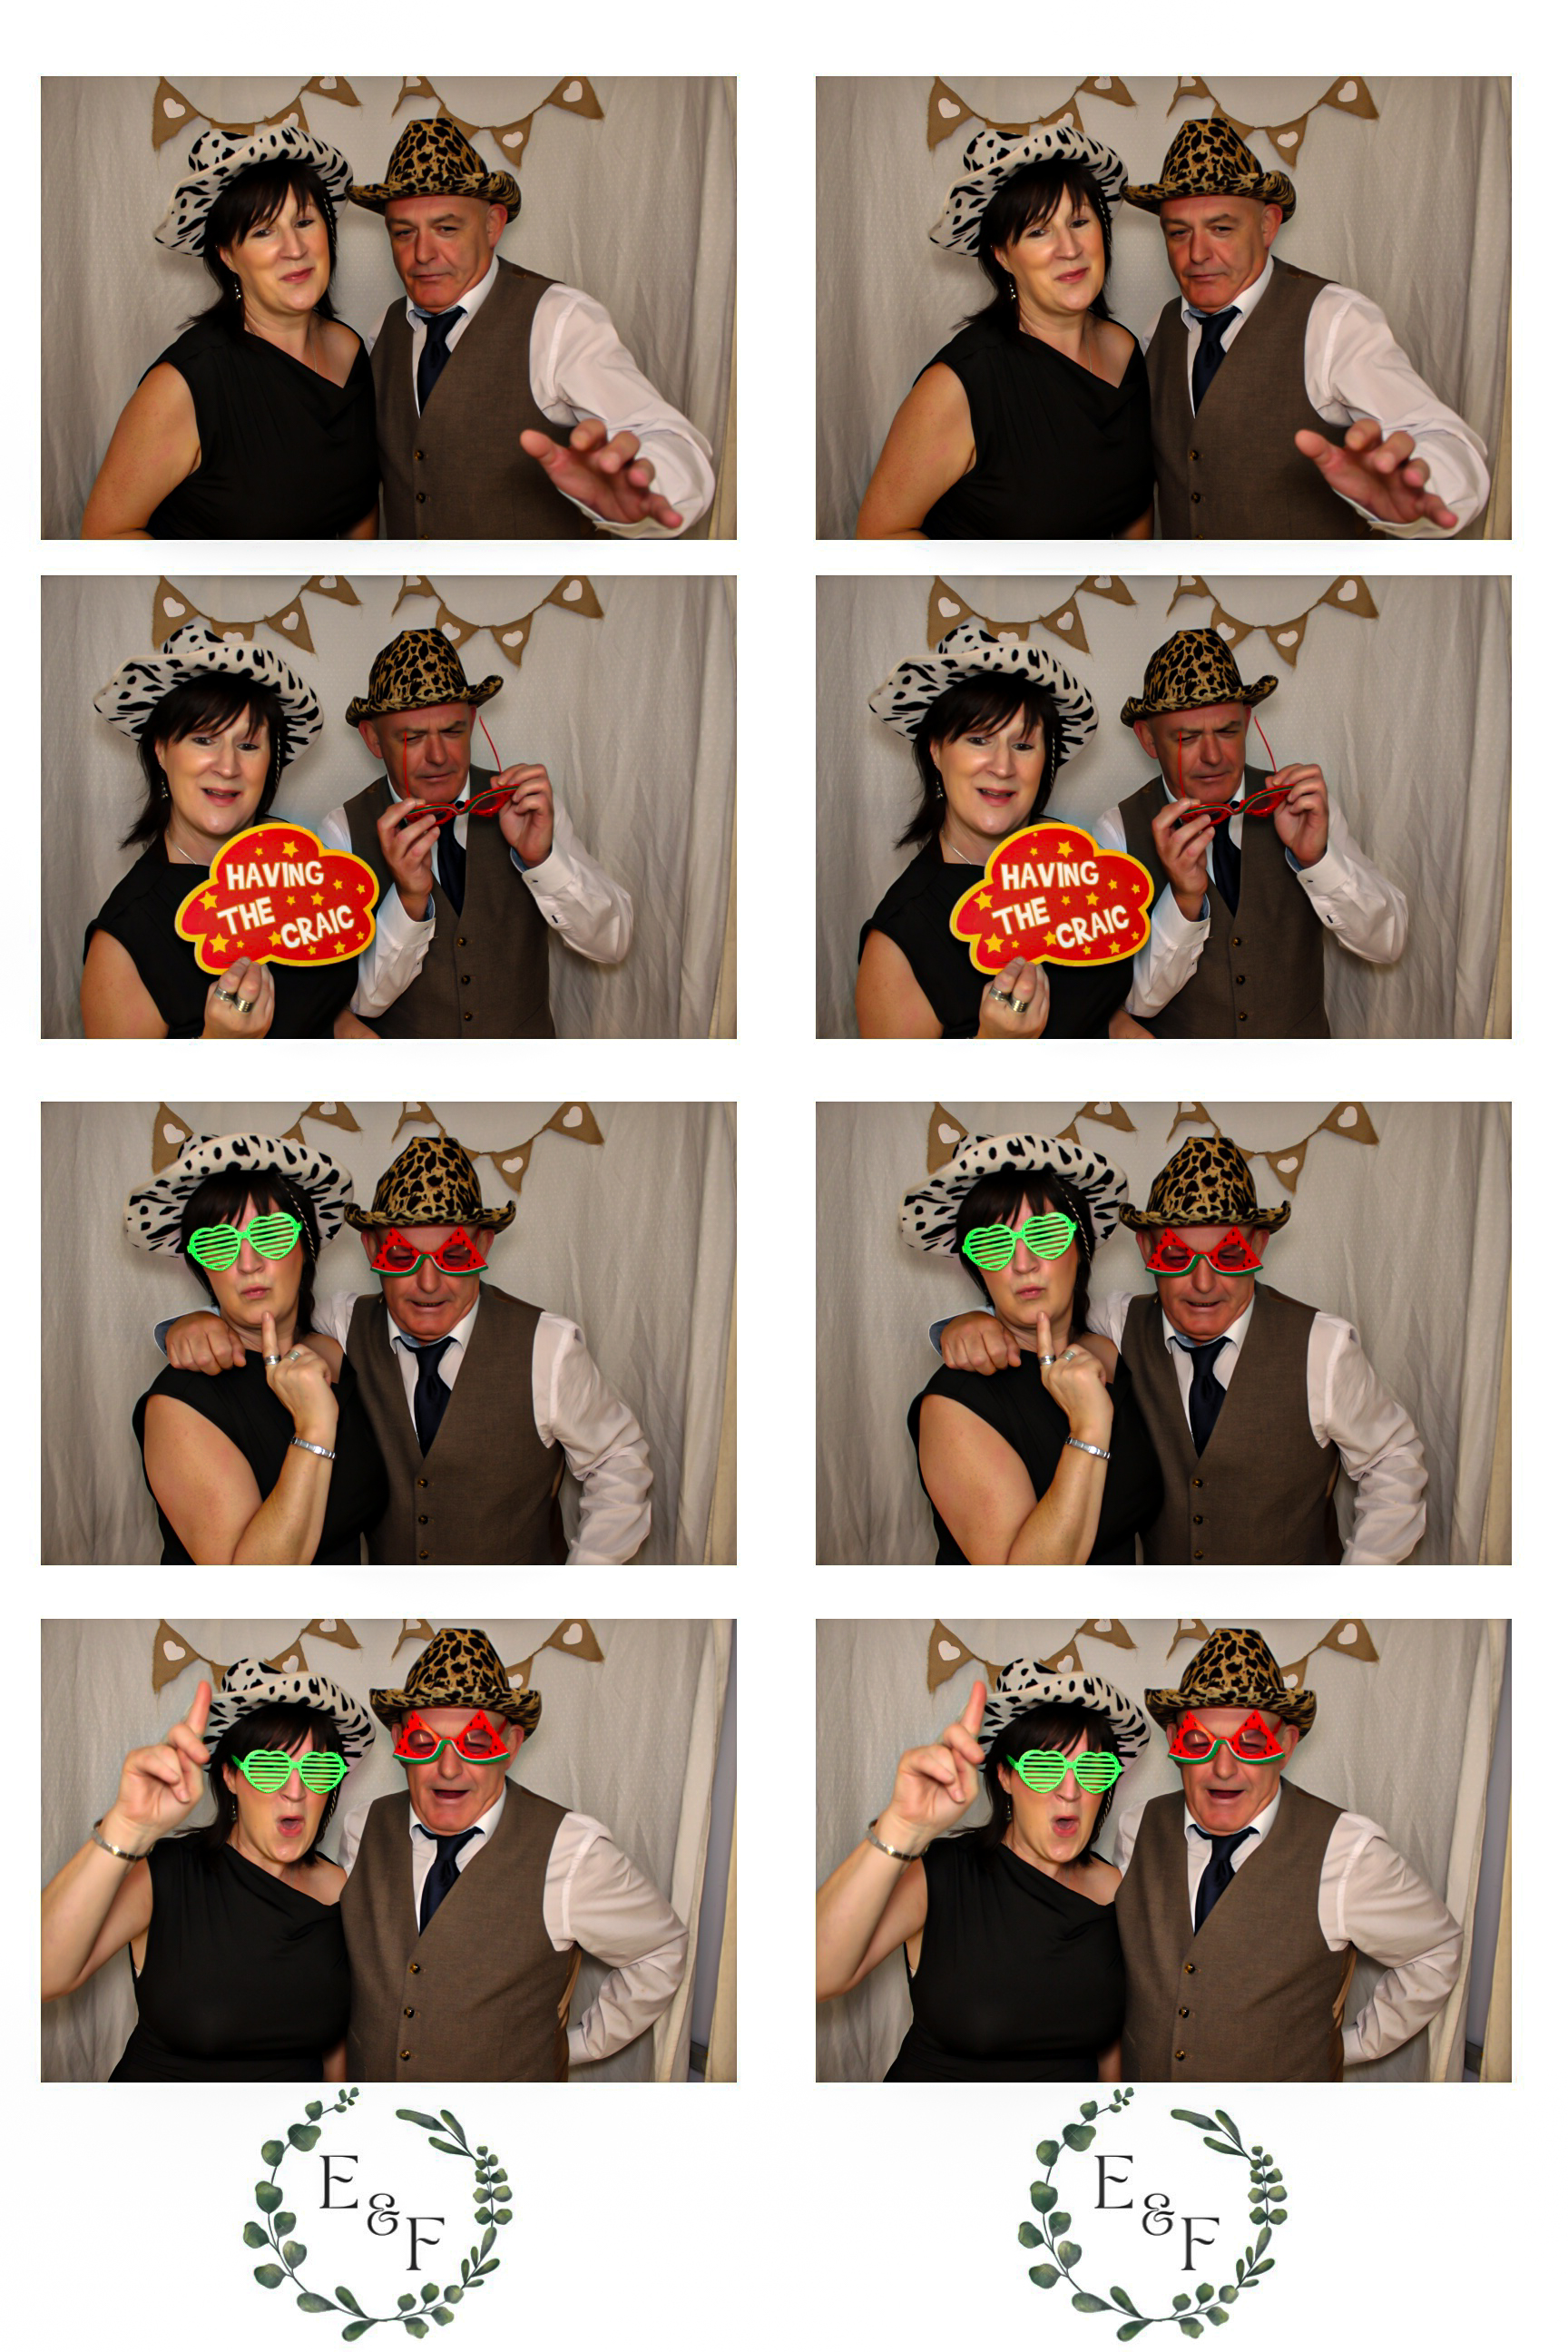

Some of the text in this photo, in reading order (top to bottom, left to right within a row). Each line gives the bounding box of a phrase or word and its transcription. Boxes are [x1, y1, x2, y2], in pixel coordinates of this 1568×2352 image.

[226, 860, 325, 890] HAVING
[1001, 860, 1100, 890] HAVING
[216, 896, 276, 936] THE
[280, 905, 355, 948] CRAIC
[991, 896, 1051, 936] THE
[1055, 905, 1130, 948] CRAIC
